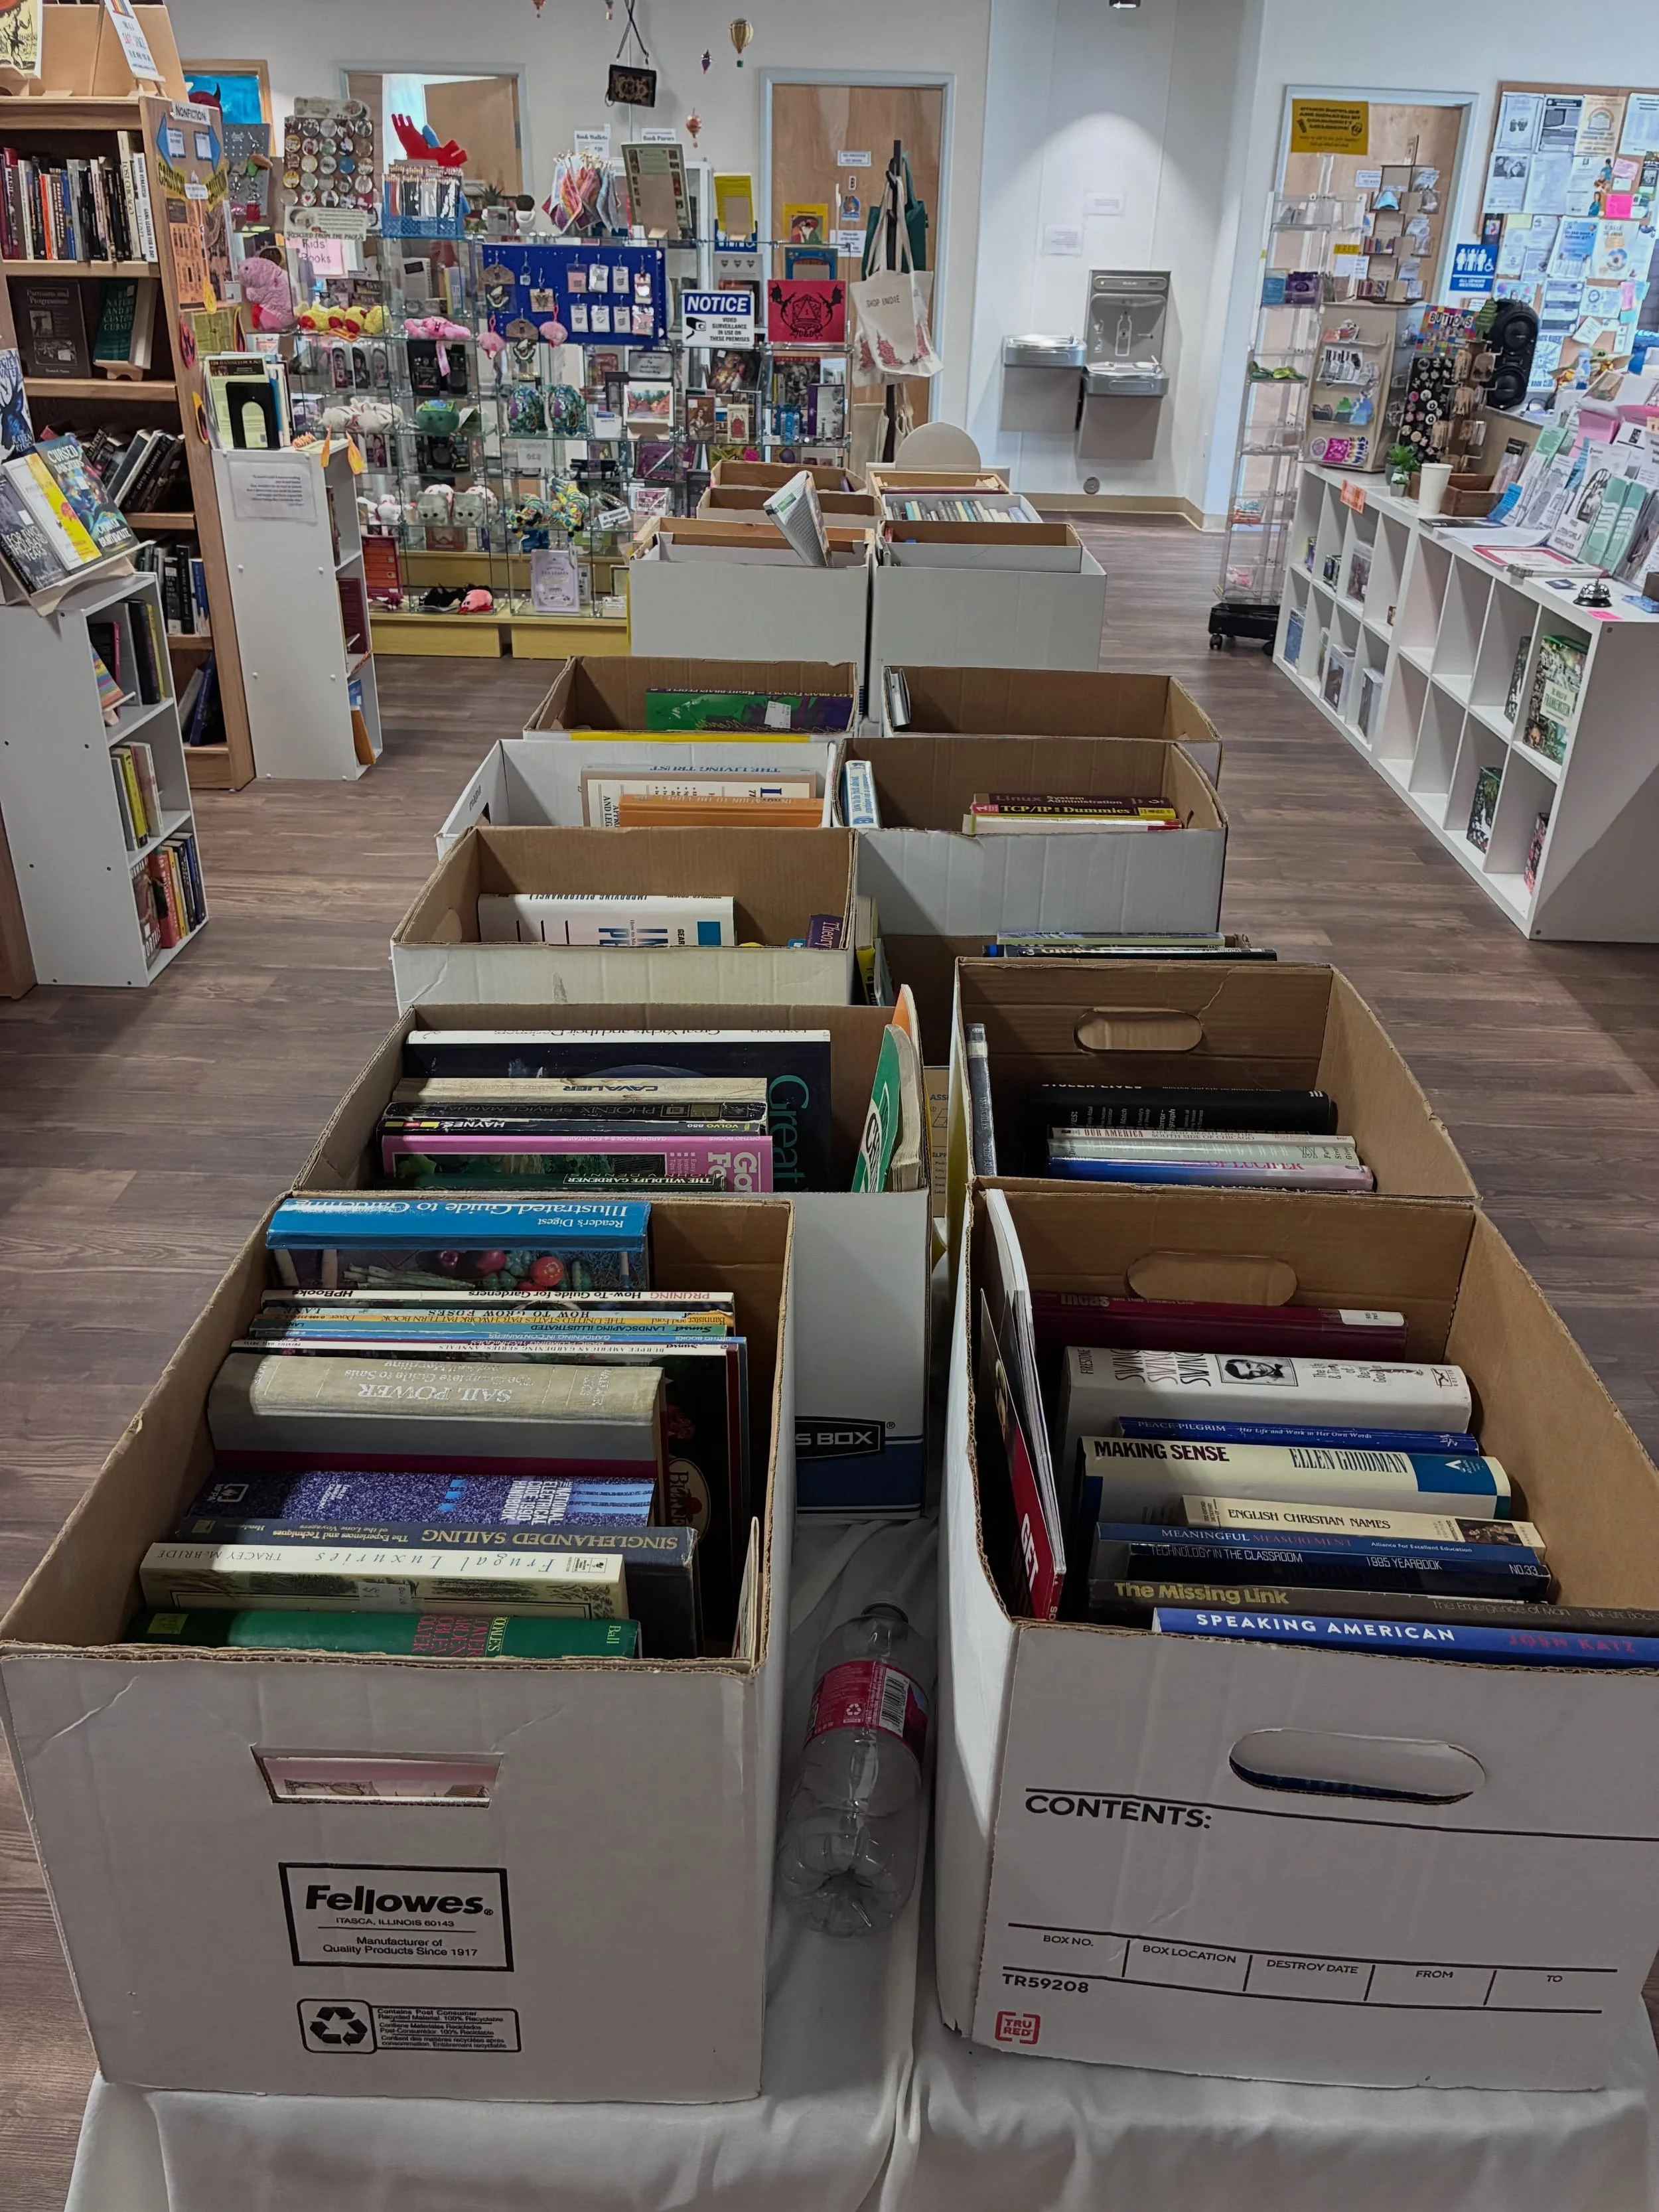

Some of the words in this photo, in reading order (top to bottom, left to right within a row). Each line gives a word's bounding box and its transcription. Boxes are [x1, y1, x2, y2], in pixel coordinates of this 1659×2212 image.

[175, 106, 206, 121] NONFICTION
[687, 296, 749, 313] NOTICE
[1430, 313, 1472, 327] BUTTONS
[48, 445, 78, 463] CURSED
[7, 531, 22, 544] FOR
[23, 526, 39, 537] TWO
[9, 534, 48, 556] THOUSAND
[25, 548, 47, 562] YEARS
[1001, 805, 1052, 814] TCP/IP
[1064, 806, 1130, 814] Dummies
[820, 921, 840, 948] Theory
[768, 1075, 810, 1181] Great
[293, 1199, 412, 1213] Gardening
[419, 1202, 437, 1212] to
[443, 1202, 512, 1215] Guide
[519, 1203, 628, 1217] Illustrated
[538, 1218, 574, 1227] Digest
[577, 1218, 623, 1228] Reader's
[534, 1291, 551, 1299] for
[1079, 1349, 1092, 1374] FIRESTONE
[357, 1383, 450, 1401] POWER
[456, 1388, 513, 1403] SAIL
[1137, 1420, 1171, 1430] PEACE
[1175, 1423, 1226, 1432] PILGRIM
[817, 1432, 874, 1445] BOX
[1094, 1441, 1168, 1461] MAKING
[1171, 1443, 1230, 1461] SENSE
[1289, 1448, 1335, 1470] ELLEN
[1338, 1451, 1407, 1475] GOODMAN
[500, 1481, 528, 1520] HANDBOOK
[531, 1481, 557, 1525] ELECTRICAL
[547, 1487, 571, 1524] NATIONAL
[1228, 1509, 1279, 1522] ENGLISH
[1283, 1512, 1344, 1526] CHRISTIAN
[1349, 1517, 1390, 1530] NAMES
[273, 1528, 319, 1538] Techniques
[341, 1530, 389, 1542] Experiences
[423, 1530, 506, 1545] SAILING
[512, 1531, 678, 1550] SINGLEHANDED
[1161, 1528, 1250, 1542] MEANINGFUL
[1253, 1533, 1352, 1546] MEASUREMENT
[225, 1550, 282, 1561] TRACEY
[316, 1552, 437, 1569] Luxuries
[1021, 1513, 1039, 1593] GET
[1151, 1546, 1211, 1560] TECHNOLOGY
[1223, 1549, 1242, 1561] THE
[1244, 1550, 1303, 1563] CLASSROOM
[1393, 1558, 1443, 1571] YEARBOOK
[1510, 1563, 1539, 1576] NO.33
[459, 1554, 553, 1572] Frugal
[1114, 1582, 1155, 1599] The
[1159, 1584, 1238, 1603] Missing
[1244, 1587, 1289, 1604] Link
[1457, 1601, 1524, 1614] Emergence
[607, 1625, 621, 1644] Ball
[1196, 1613, 1316, 1633] SPEAKING
[1328, 1621, 1455, 1641] AMERICAN
[1510, 1633, 1569, 1649] JOSH
[1579, 1638, 1636, 1653] KATZ
[1025, 1794, 1212, 1829] CONTENTS:
[305, 1885, 484, 1915] Fellowes
[356, 1937, 429, 1947] Manufacturer
[1043, 1935, 1068, 1945] BOX
[1070, 1937, 1094, 1947] NO.
[323, 1945, 361, 1955] Quality
[364, 1946, 413, 1955] Products
[416, 1947, 447, 1956] Since
[1142, 1944, 1169, 1954] BOX
[1171, 1947, 1236, 1964] LOCATION
[1266, 1959, 1323, 1973] DESTROY
[1327, 1964, 1359, 1975] DATE
[1415, 1970, 1453, 1979] FROM
[1001, 1973, 1090, 1993] TR59208
[1004, 2018, 1033, 2029] TRU
[1006, 2028, 1032, 2037] RED
